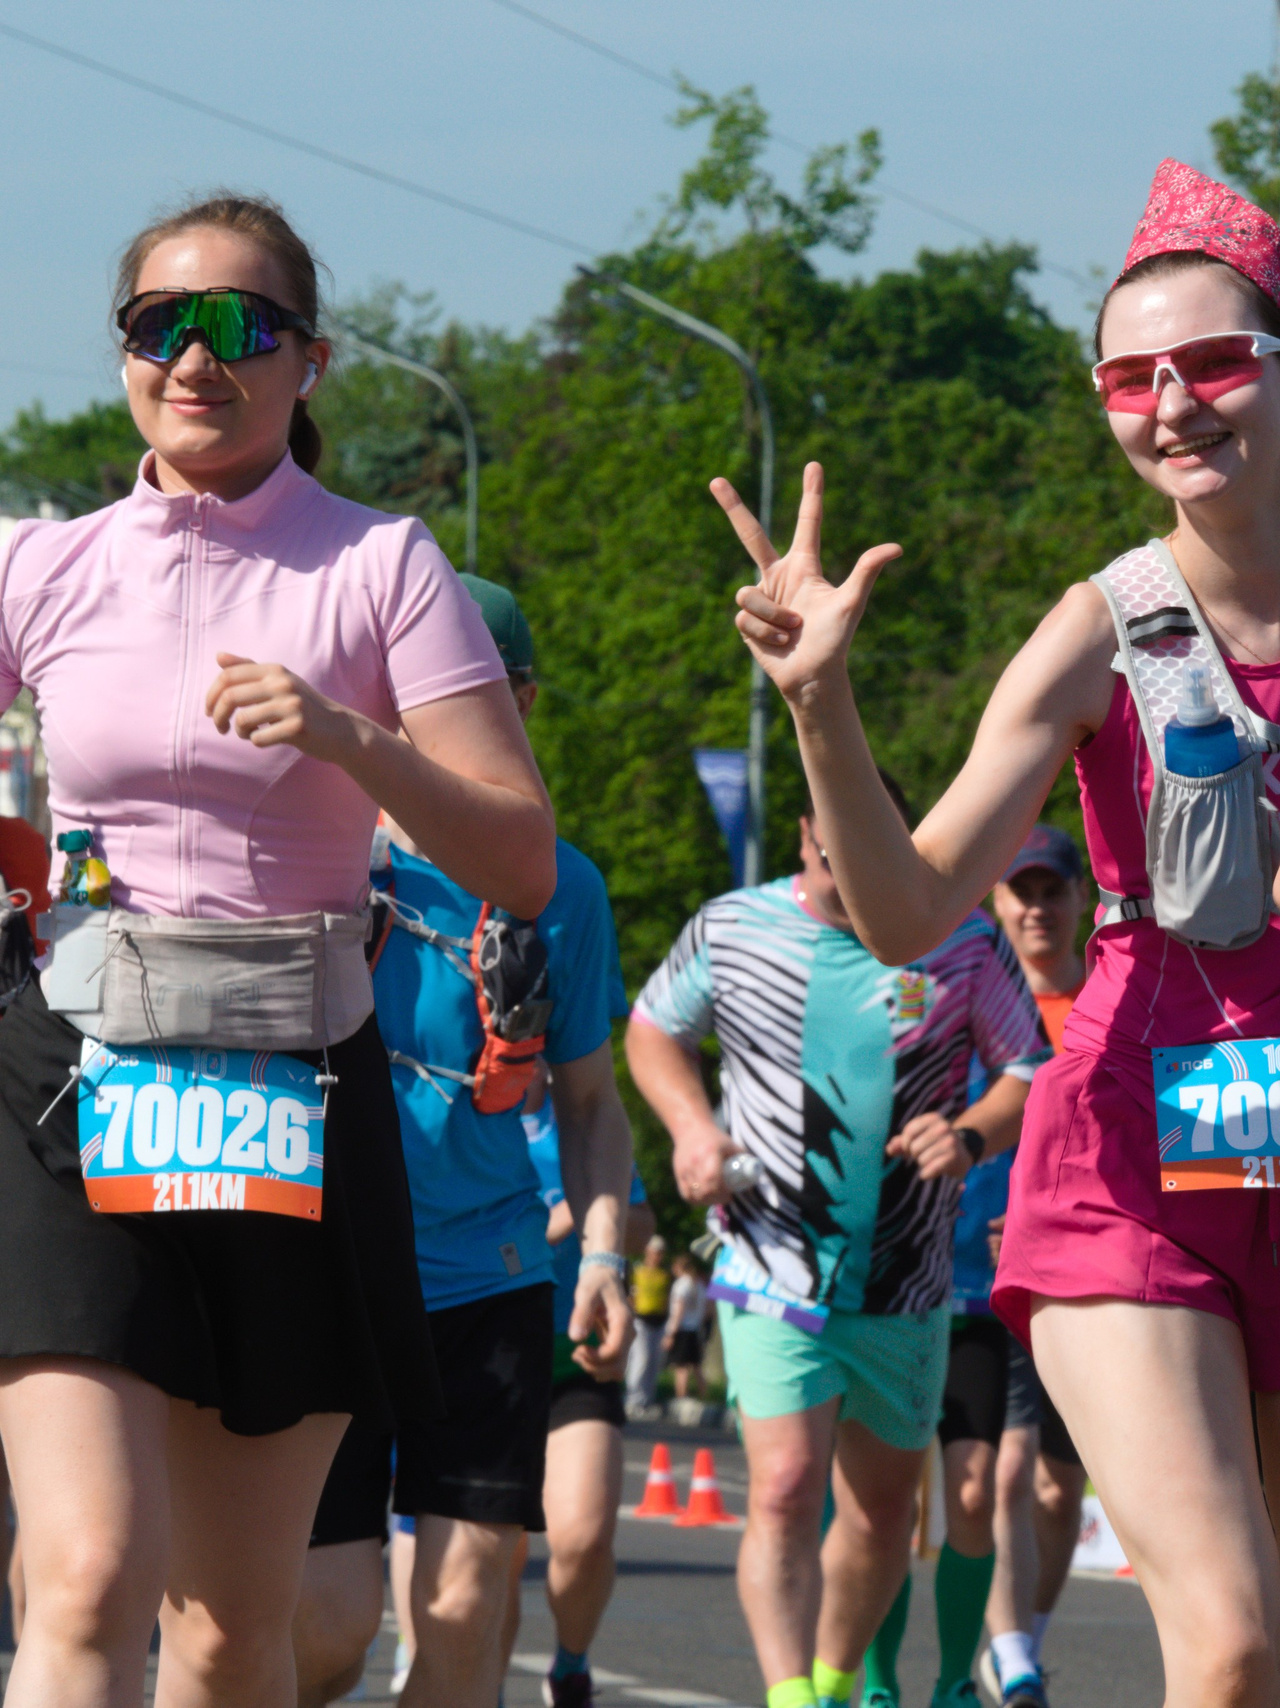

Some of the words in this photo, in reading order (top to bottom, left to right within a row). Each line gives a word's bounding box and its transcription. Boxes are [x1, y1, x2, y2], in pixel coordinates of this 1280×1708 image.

[108, 1054, 139, 1067] ПСБ
[189, 1049, 228, 1081] 10
[1182, 1058, 1213, 1071] ПСБ
[94, 1083, 310, 1175] 70026
[153, 1172, 246, 1212] 21.1KM
